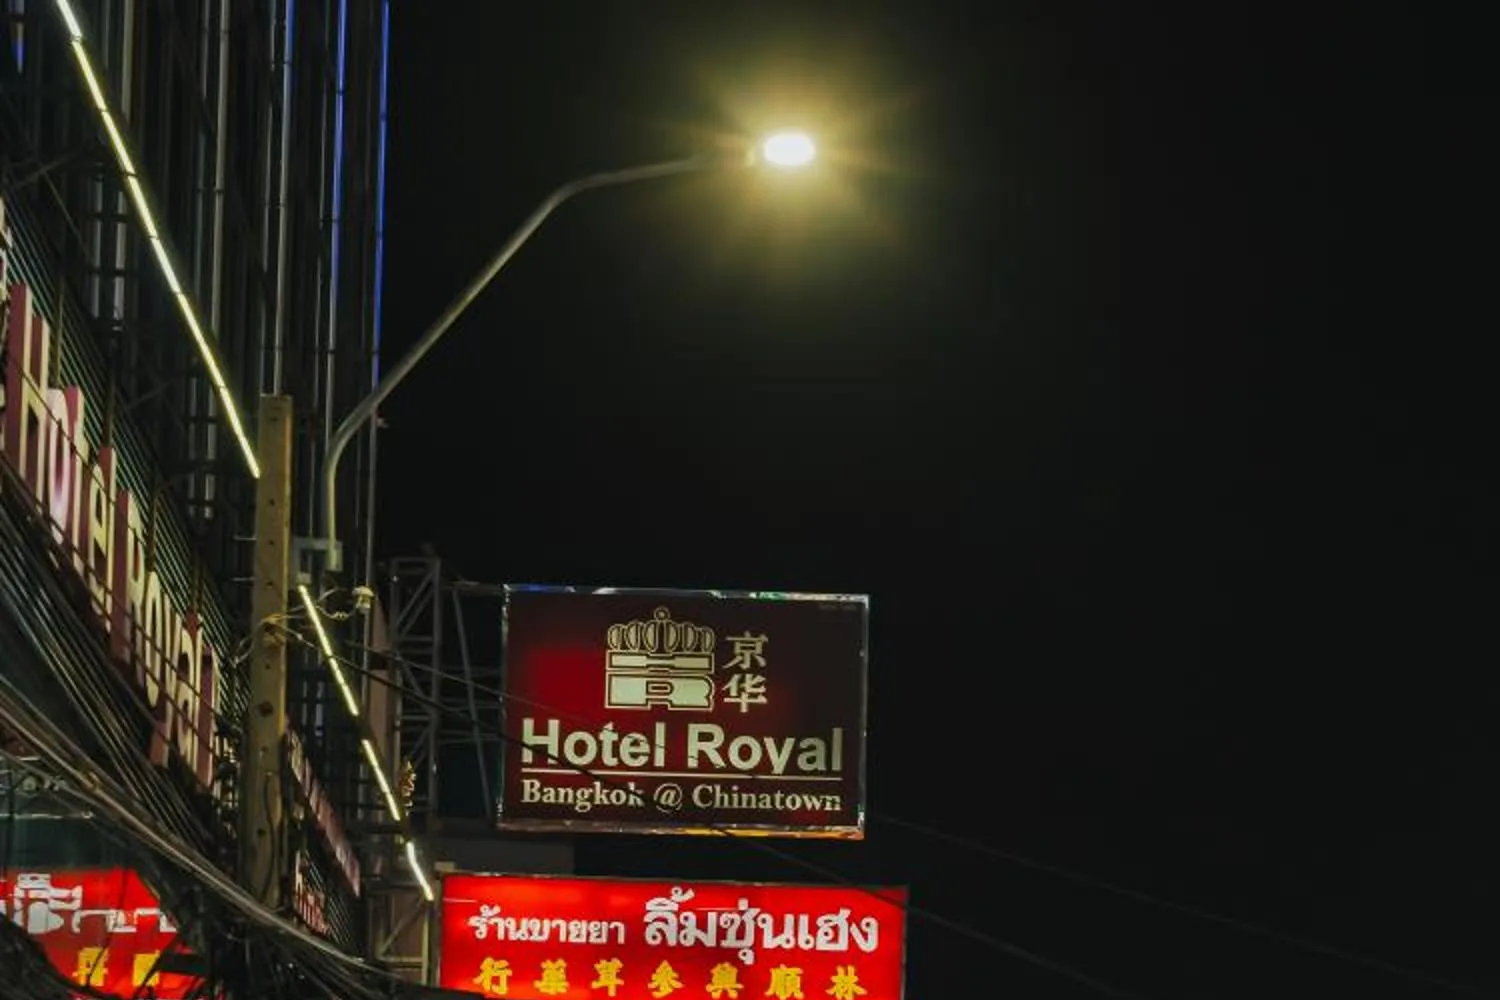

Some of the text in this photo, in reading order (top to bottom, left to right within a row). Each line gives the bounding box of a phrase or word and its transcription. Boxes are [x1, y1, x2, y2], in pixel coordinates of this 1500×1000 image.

[722, 631, 769, 713] 京华
[522, 717, 844, 774] Hotel Royal
[522, 779, 645, 813] Bangkok
[692, 784, 843, 812] Chinatown
